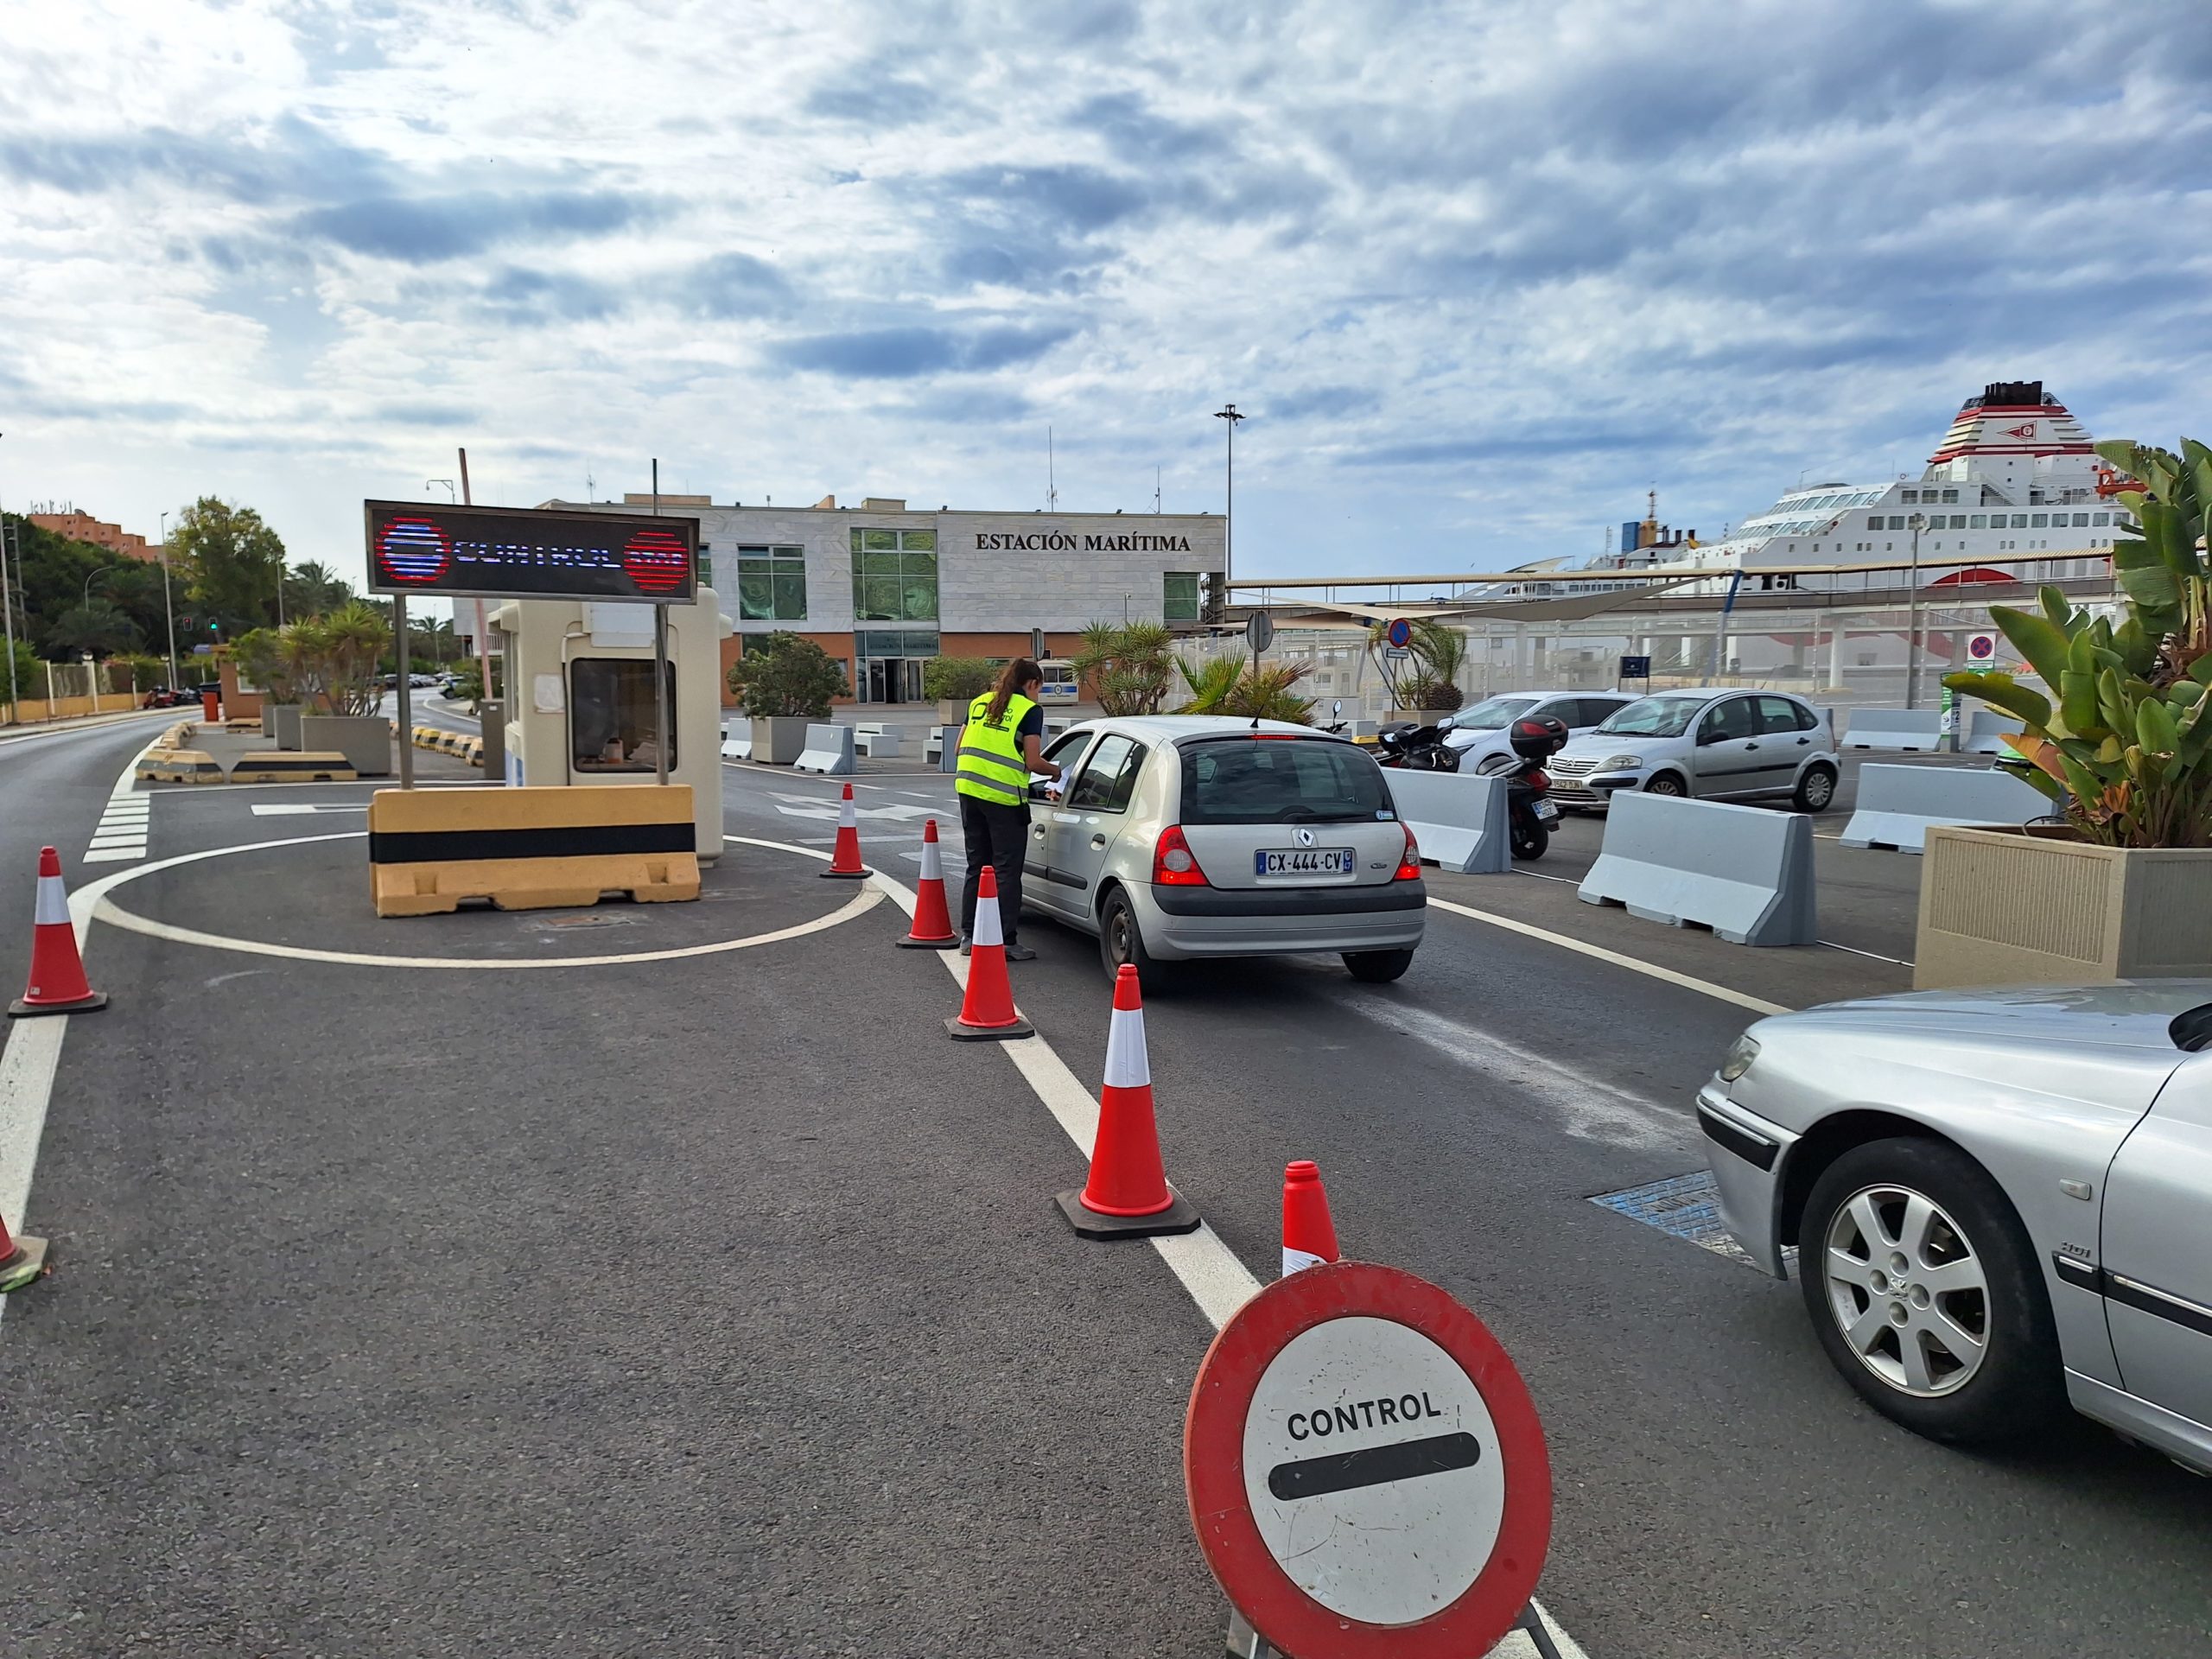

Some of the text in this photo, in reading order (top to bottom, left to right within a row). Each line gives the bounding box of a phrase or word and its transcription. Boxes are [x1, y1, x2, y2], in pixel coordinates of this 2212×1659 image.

[976, 531, 1191, 550] ESTACIÓN MARÍTIMA
[1268, 853, 1341, 871] CX-444-CV
[1287, 1392, 1441, 1440] CONTROL
